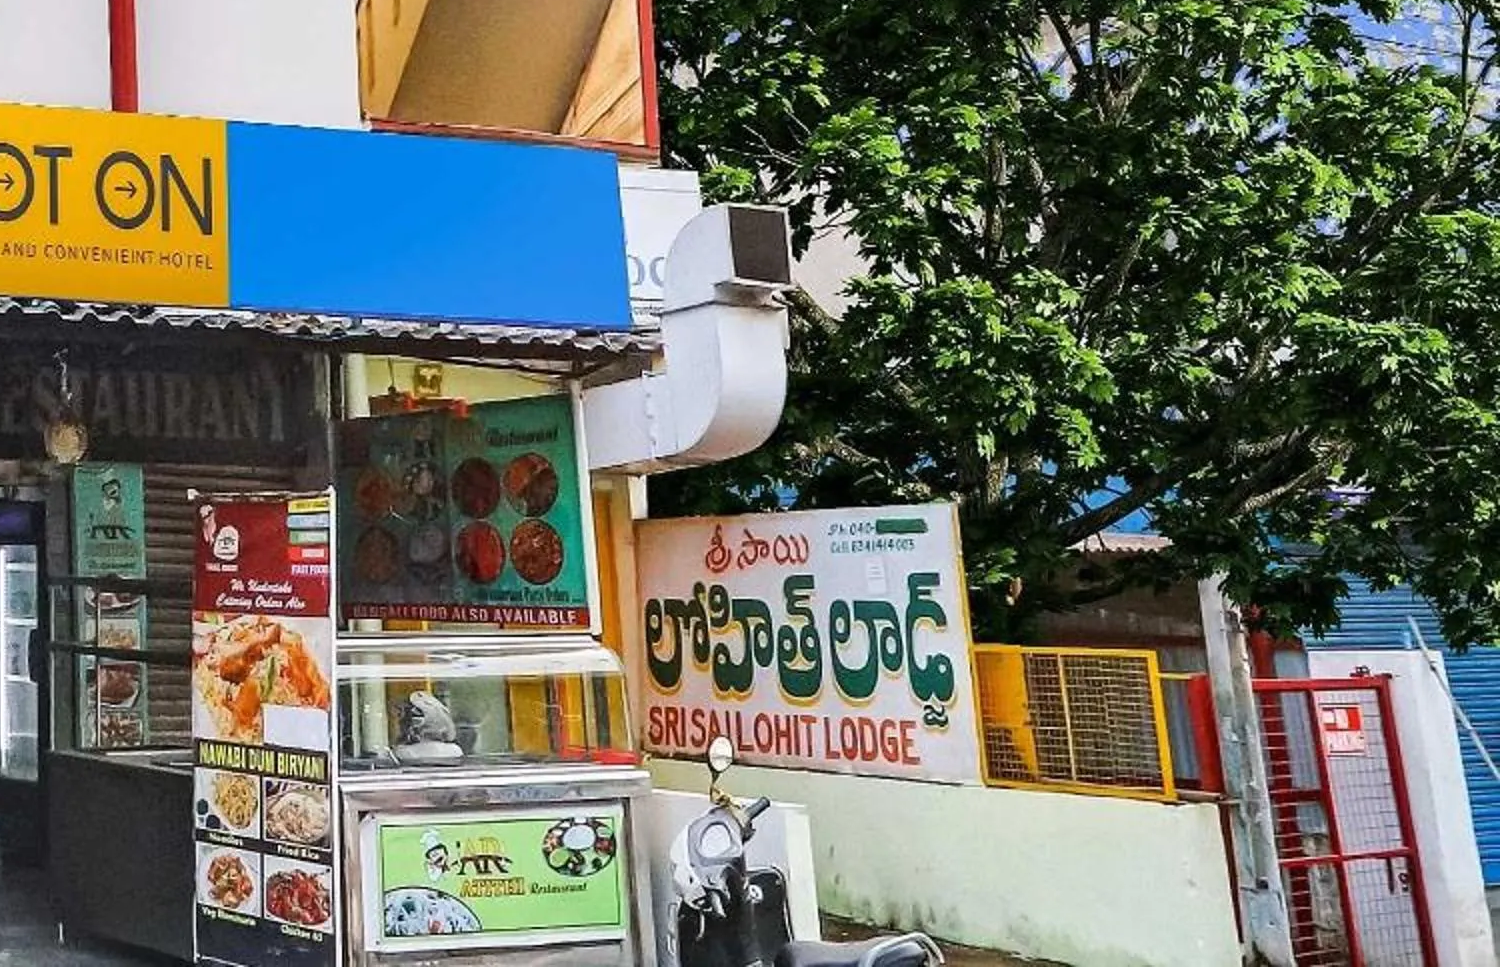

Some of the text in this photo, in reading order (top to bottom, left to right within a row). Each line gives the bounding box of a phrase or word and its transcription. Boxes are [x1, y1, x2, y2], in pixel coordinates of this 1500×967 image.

[95, 150, 213, 236] ON
[1, 242, 37, 258] AND
[159, 252, 213, 270] HOTEL
[705, 522, 810, 573] శ్రీ సాయి
[451, 607, 488, 622] ALSO
[493, 608, 578, 625] AVAILABLE
[649, 706, 921, 766] SRI SAI LOHIT LODGE
[200, 742, 326, 781] NAWABI DUM BIRYANI
